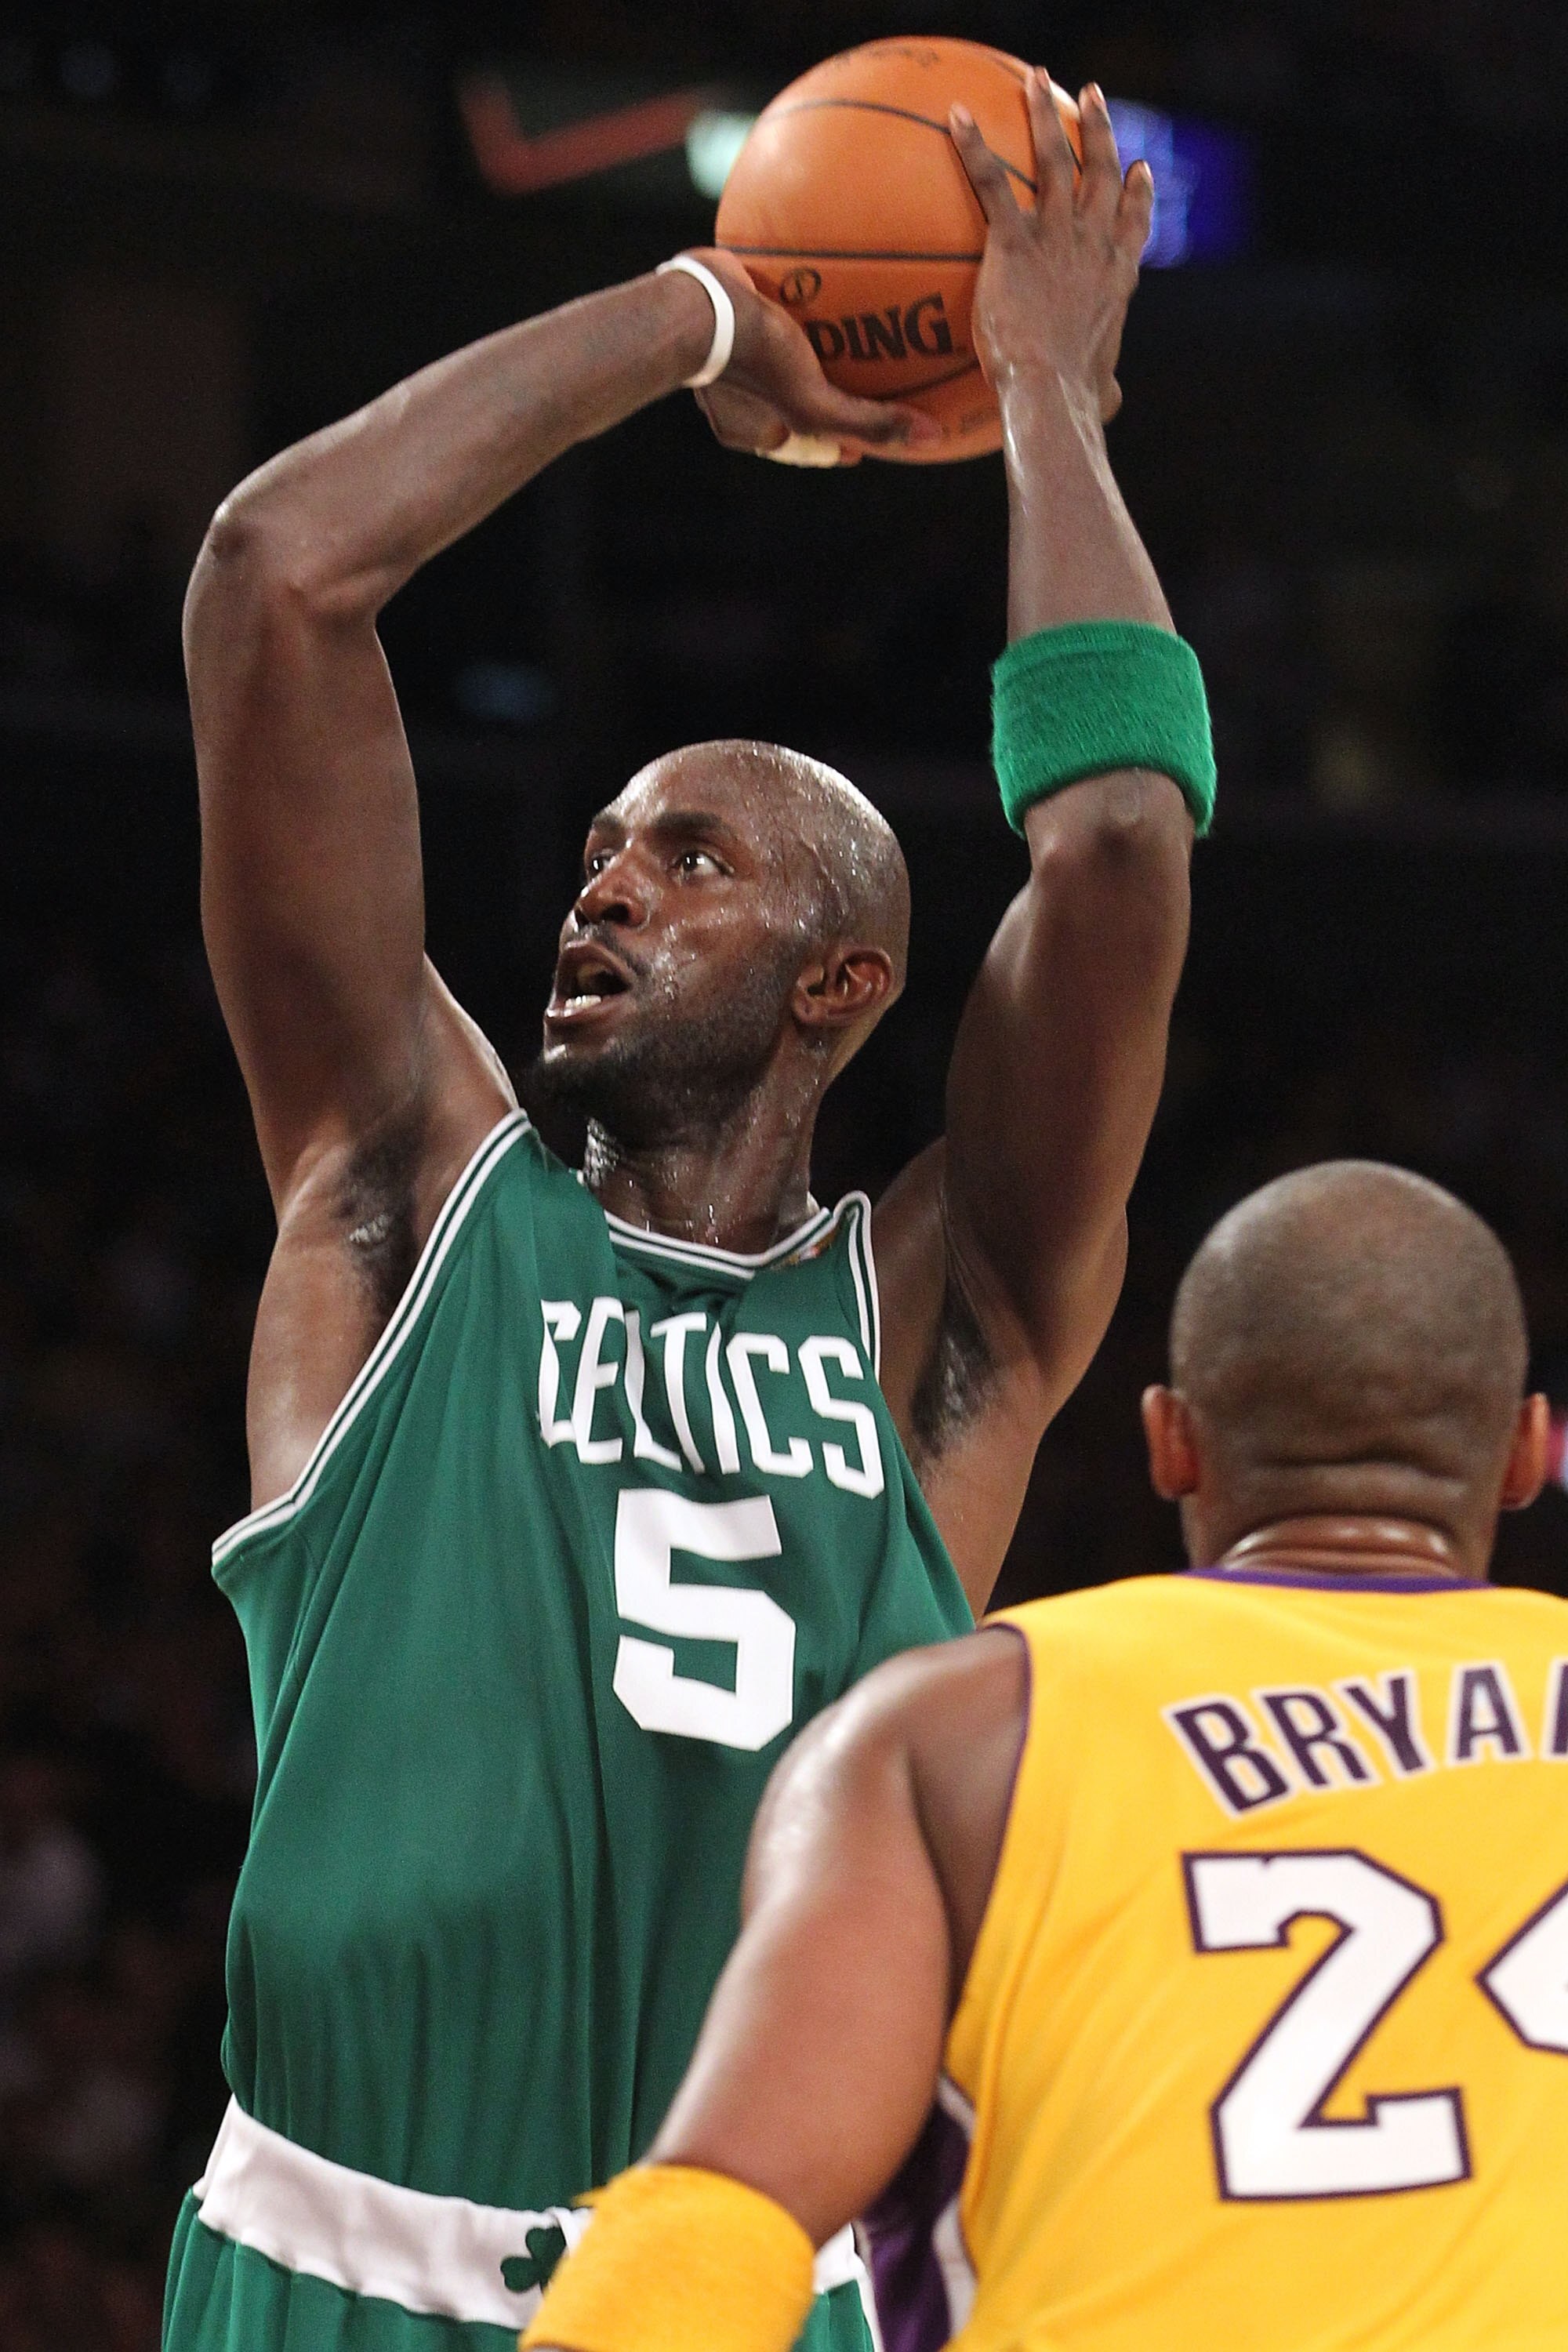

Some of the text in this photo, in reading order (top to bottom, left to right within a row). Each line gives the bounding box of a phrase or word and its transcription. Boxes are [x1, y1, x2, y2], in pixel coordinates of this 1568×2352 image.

[804, 291, 954, 361] DING
[538, 1296, 884, 1499] CELTICS
[613, 1489, 796, 1751] 5
[1163, 1658, 1568, 1817] BRYA
